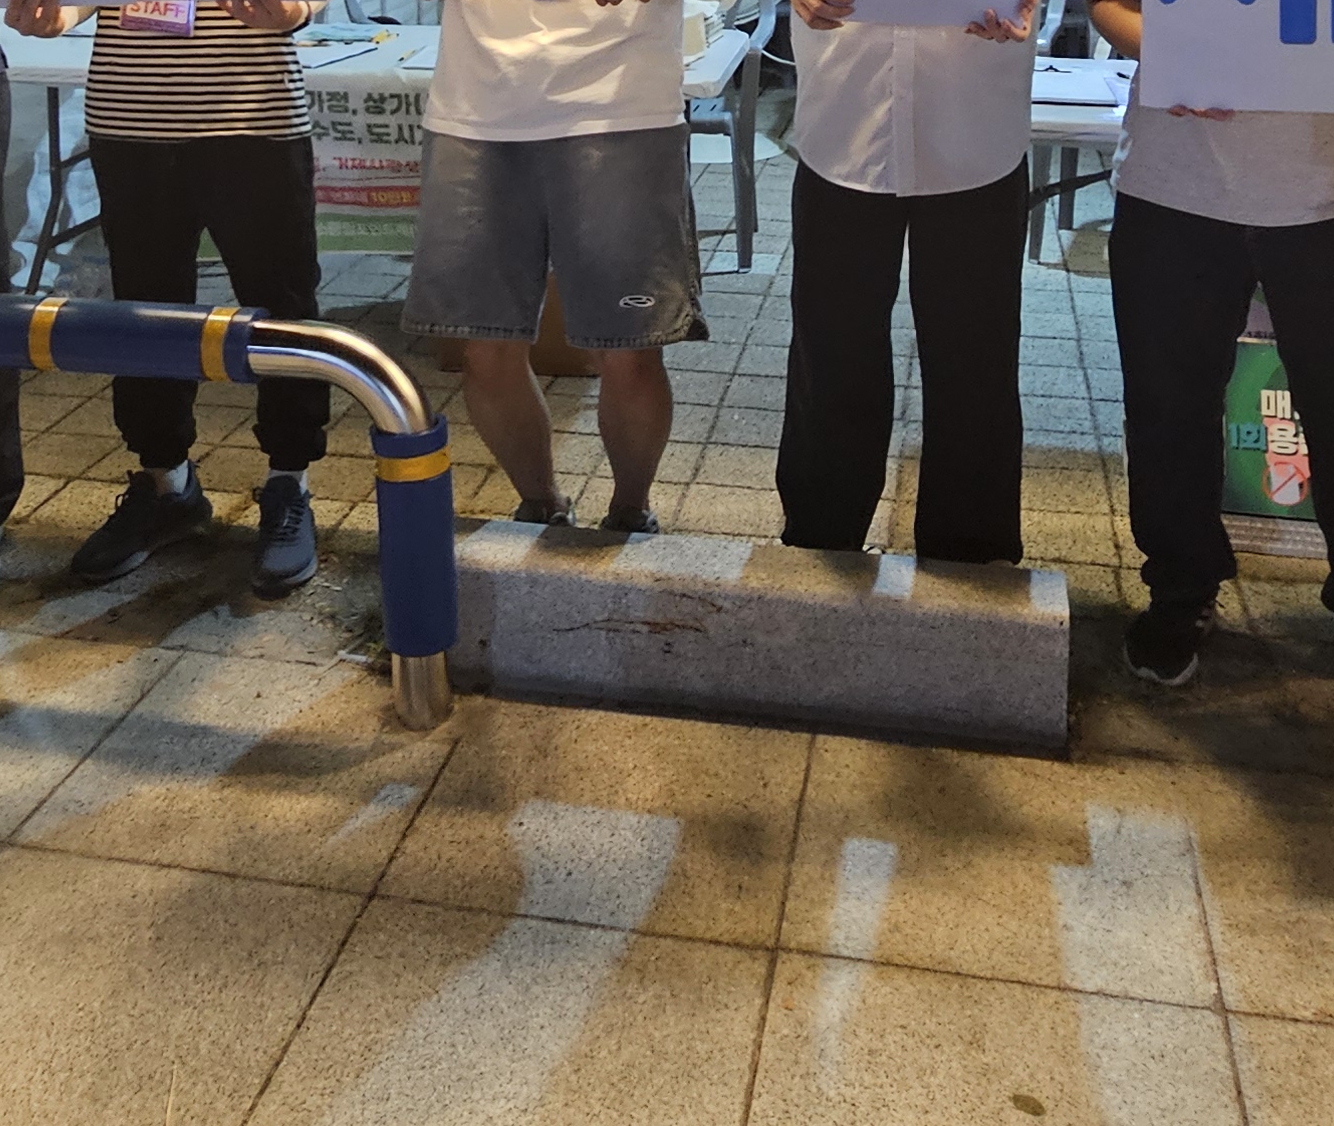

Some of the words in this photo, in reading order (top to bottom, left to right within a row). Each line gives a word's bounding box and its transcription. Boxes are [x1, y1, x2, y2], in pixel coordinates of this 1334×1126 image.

[130, 0, 186, 18] STAFF
[312, 121, 363, 144] 수도,
[367, 123, 422, 145] 도시
